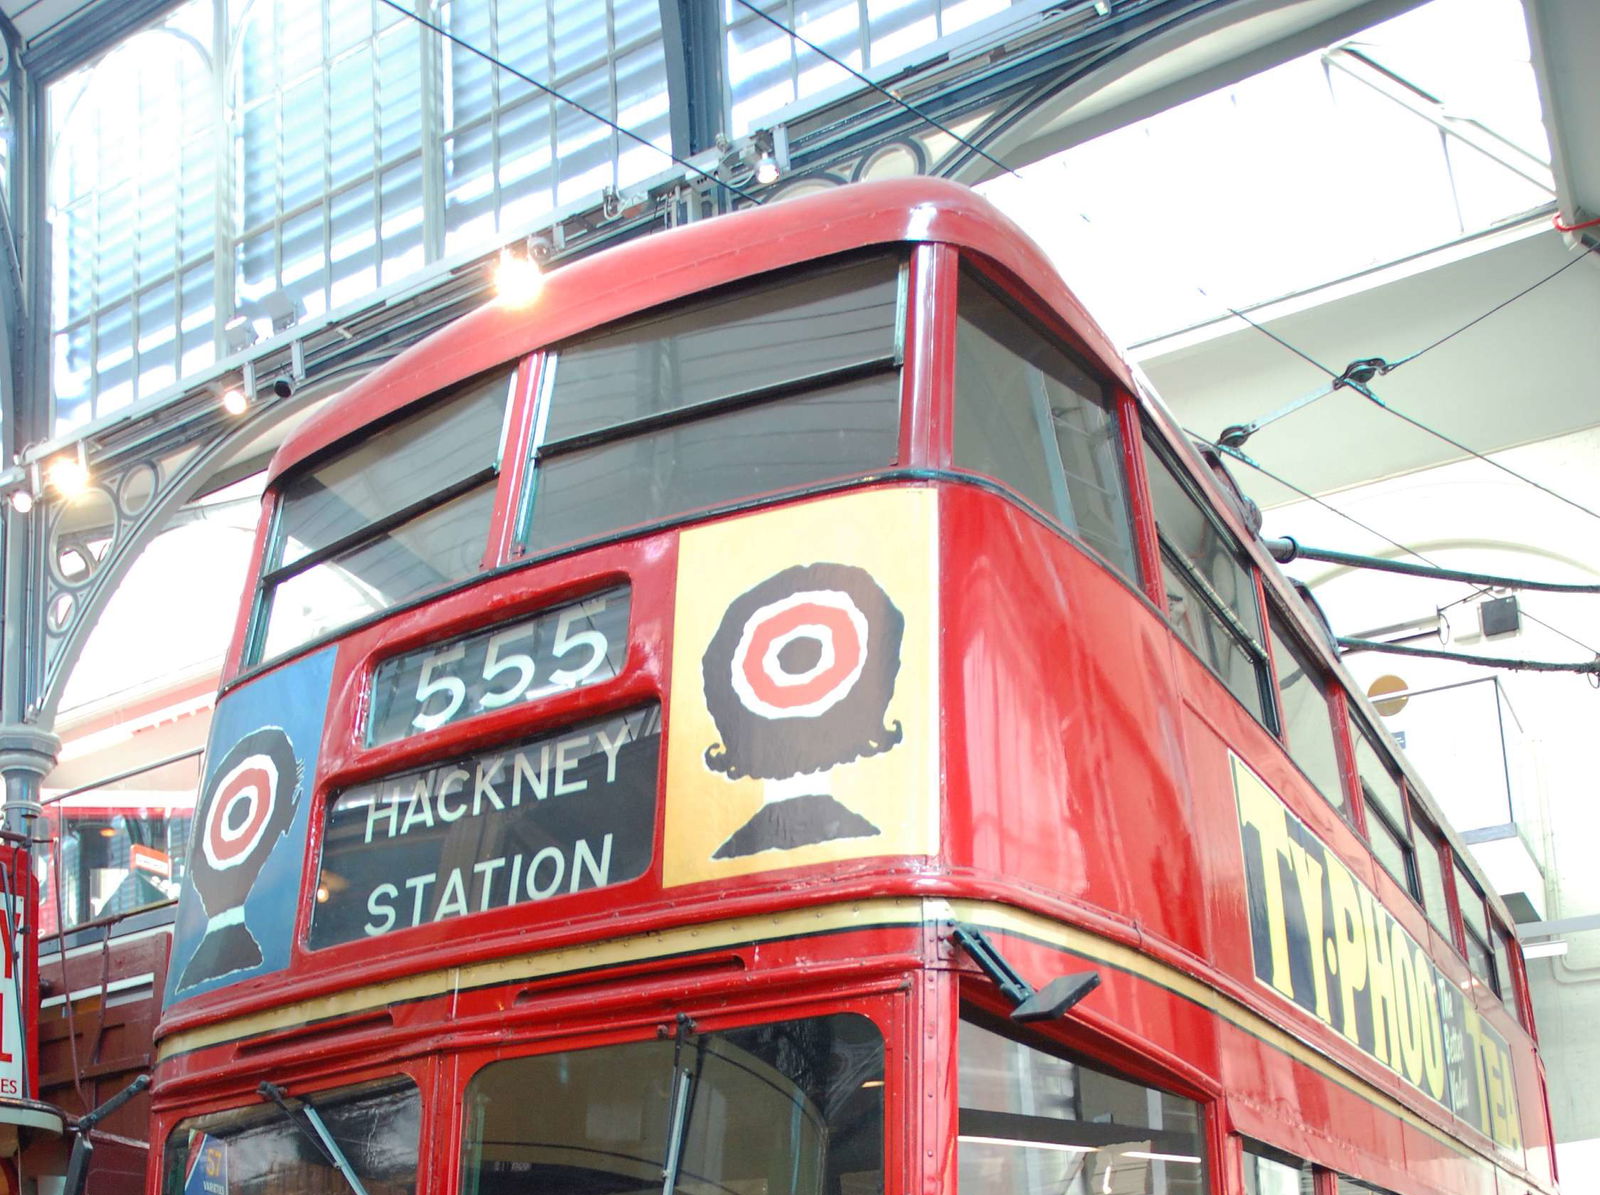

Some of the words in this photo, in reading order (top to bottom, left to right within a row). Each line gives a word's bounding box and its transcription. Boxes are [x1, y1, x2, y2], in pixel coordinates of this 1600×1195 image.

[411, 598, 609, 731] 555
[364, 723, 632, 844] HACKNEY
[363, 833, 613, 937] STATION
[1463, 996, 1521, 1152] TEA
[206, 1148, 222, 1176] 57
